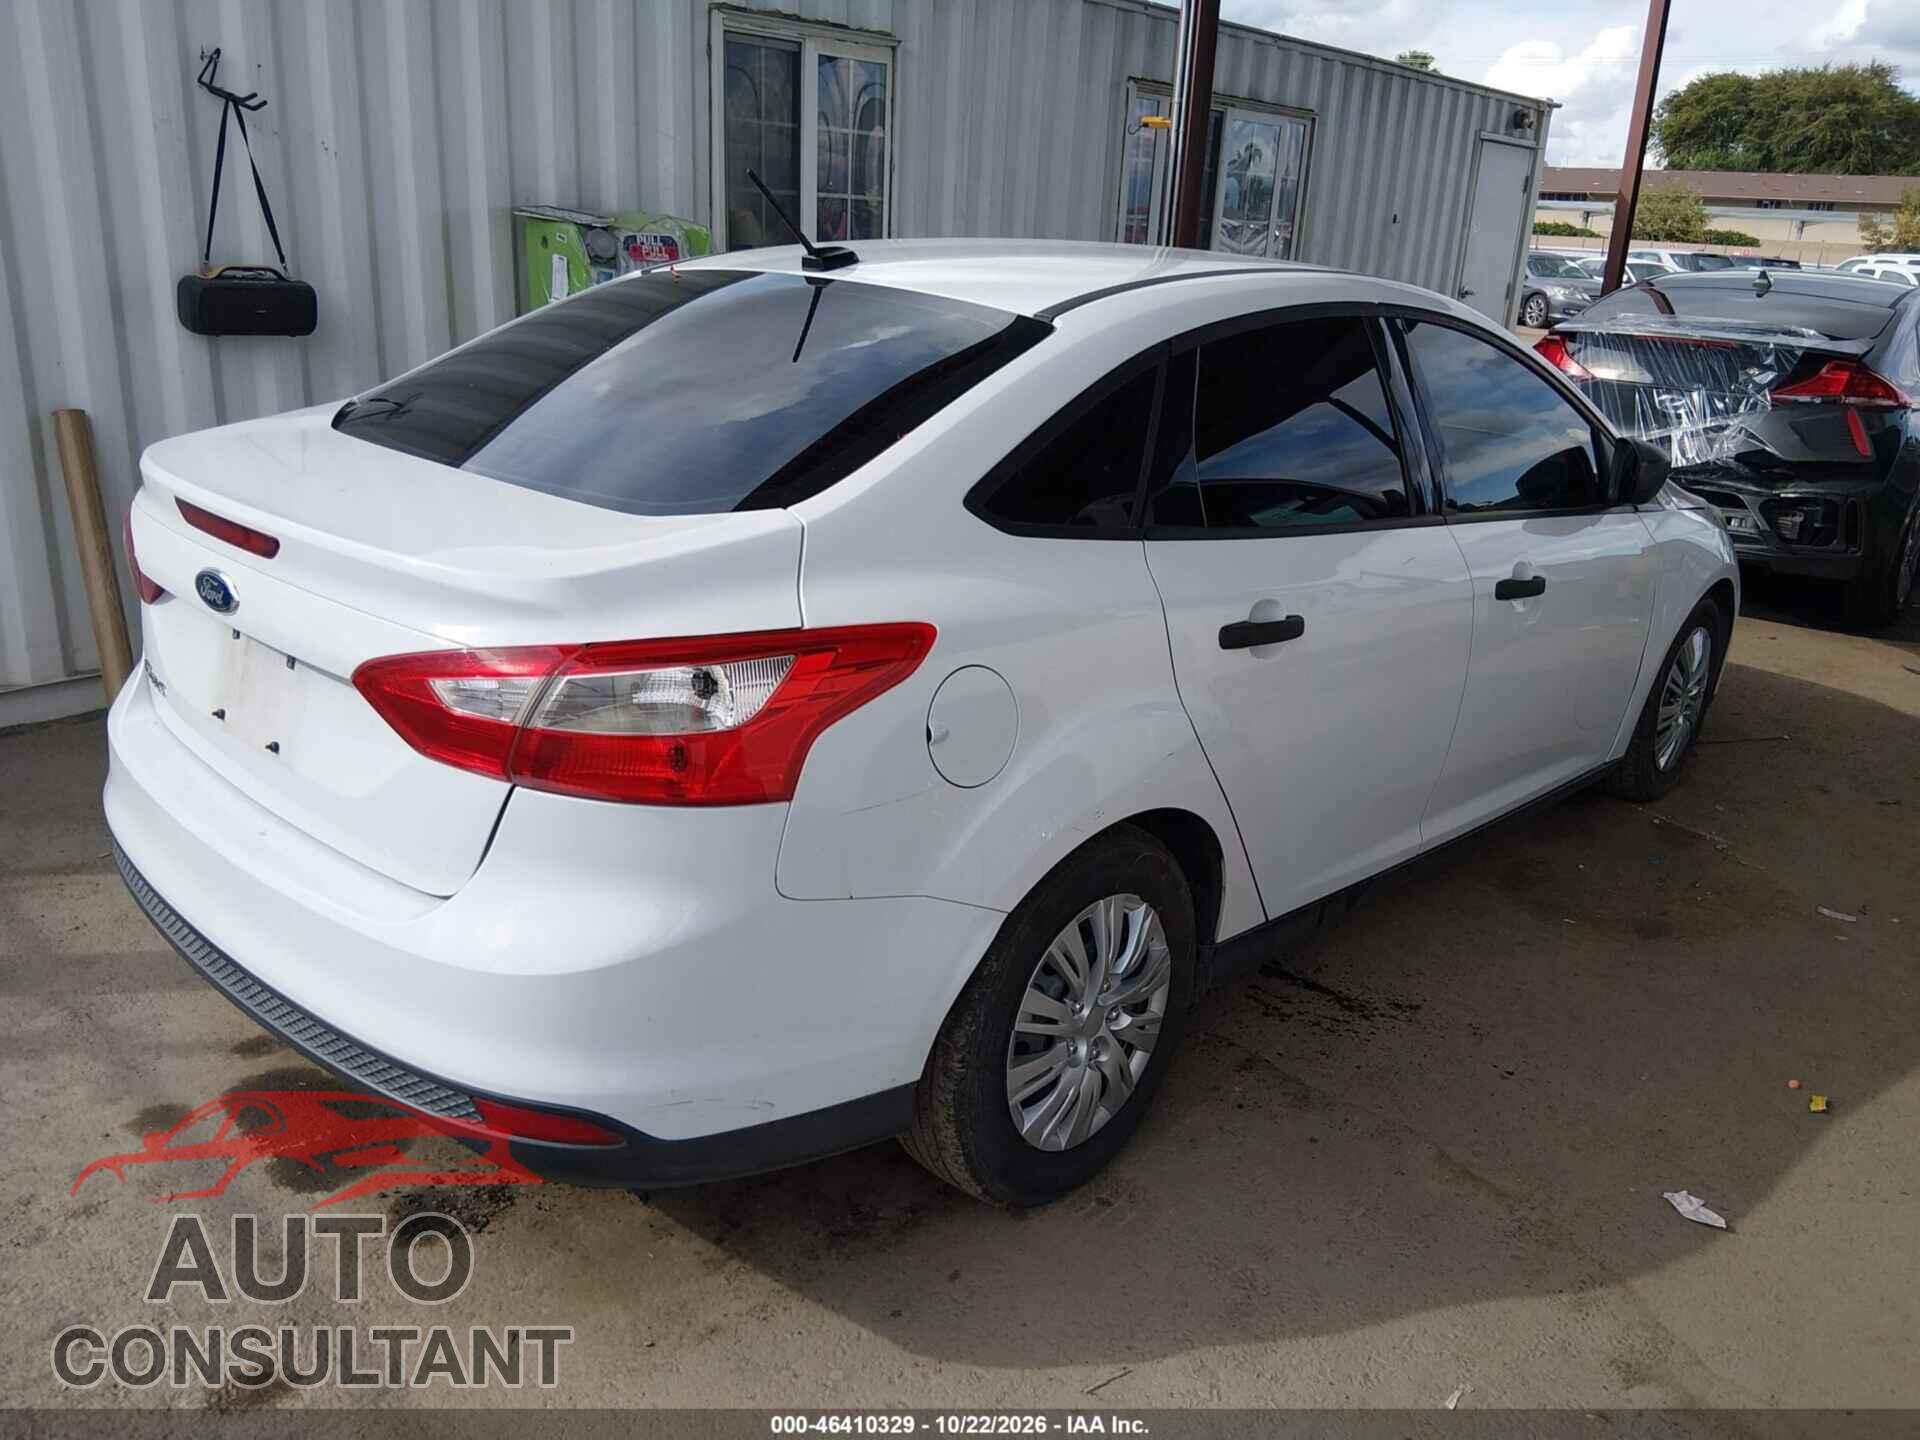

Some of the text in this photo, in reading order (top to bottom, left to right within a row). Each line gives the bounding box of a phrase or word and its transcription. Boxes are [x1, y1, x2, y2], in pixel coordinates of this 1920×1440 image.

[637, 234, 663, 246] PULL
[642, 245, 669, 258] PULL
[200, 576, 225, 605] Ford
